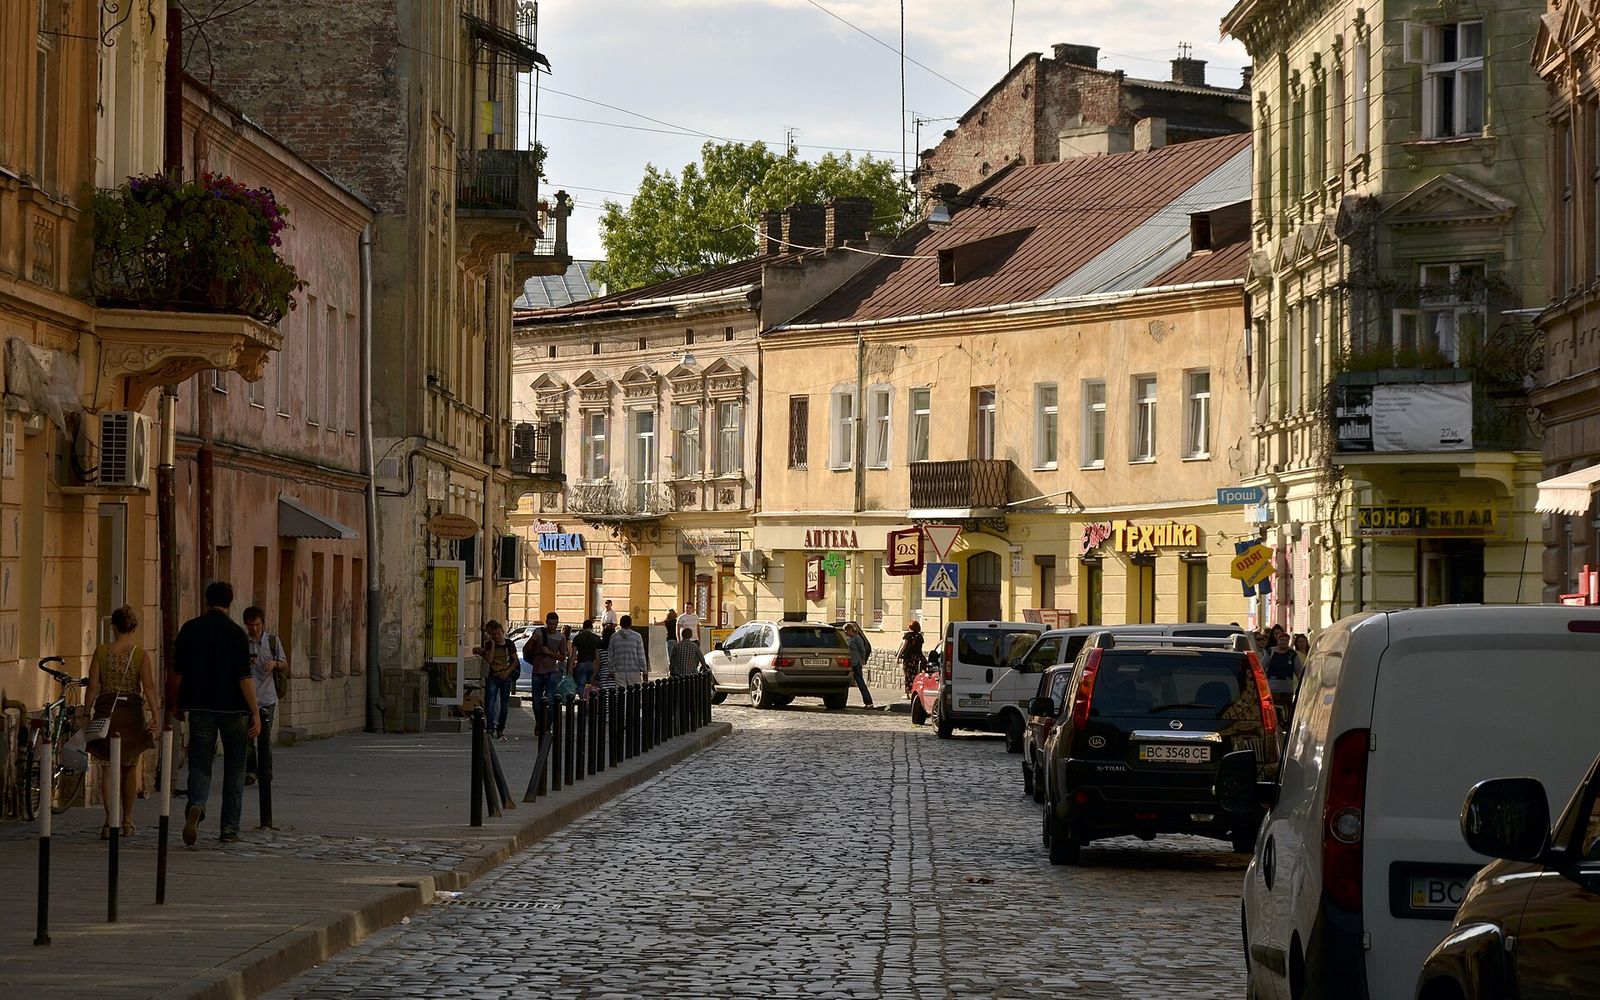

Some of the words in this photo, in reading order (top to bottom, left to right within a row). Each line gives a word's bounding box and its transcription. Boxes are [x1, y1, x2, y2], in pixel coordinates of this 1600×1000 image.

[1221, 489, 1256, 503] Гроші
[538, 533, 582, 551] АПТЕКА
[804, 529, 859, 548] АПТЕКА
[897, 543, 917, 556] D.S.
[1236, 548, 1262, 571] ОДЯГ
[1092, 738, 1102, 746] UA
[1146, 747, 1163, 758] BC
[1165, 747, 1190, 758] 3548
[1192, 748, 1208, 759] CE
[1429, 881, 1464, 904] BC
